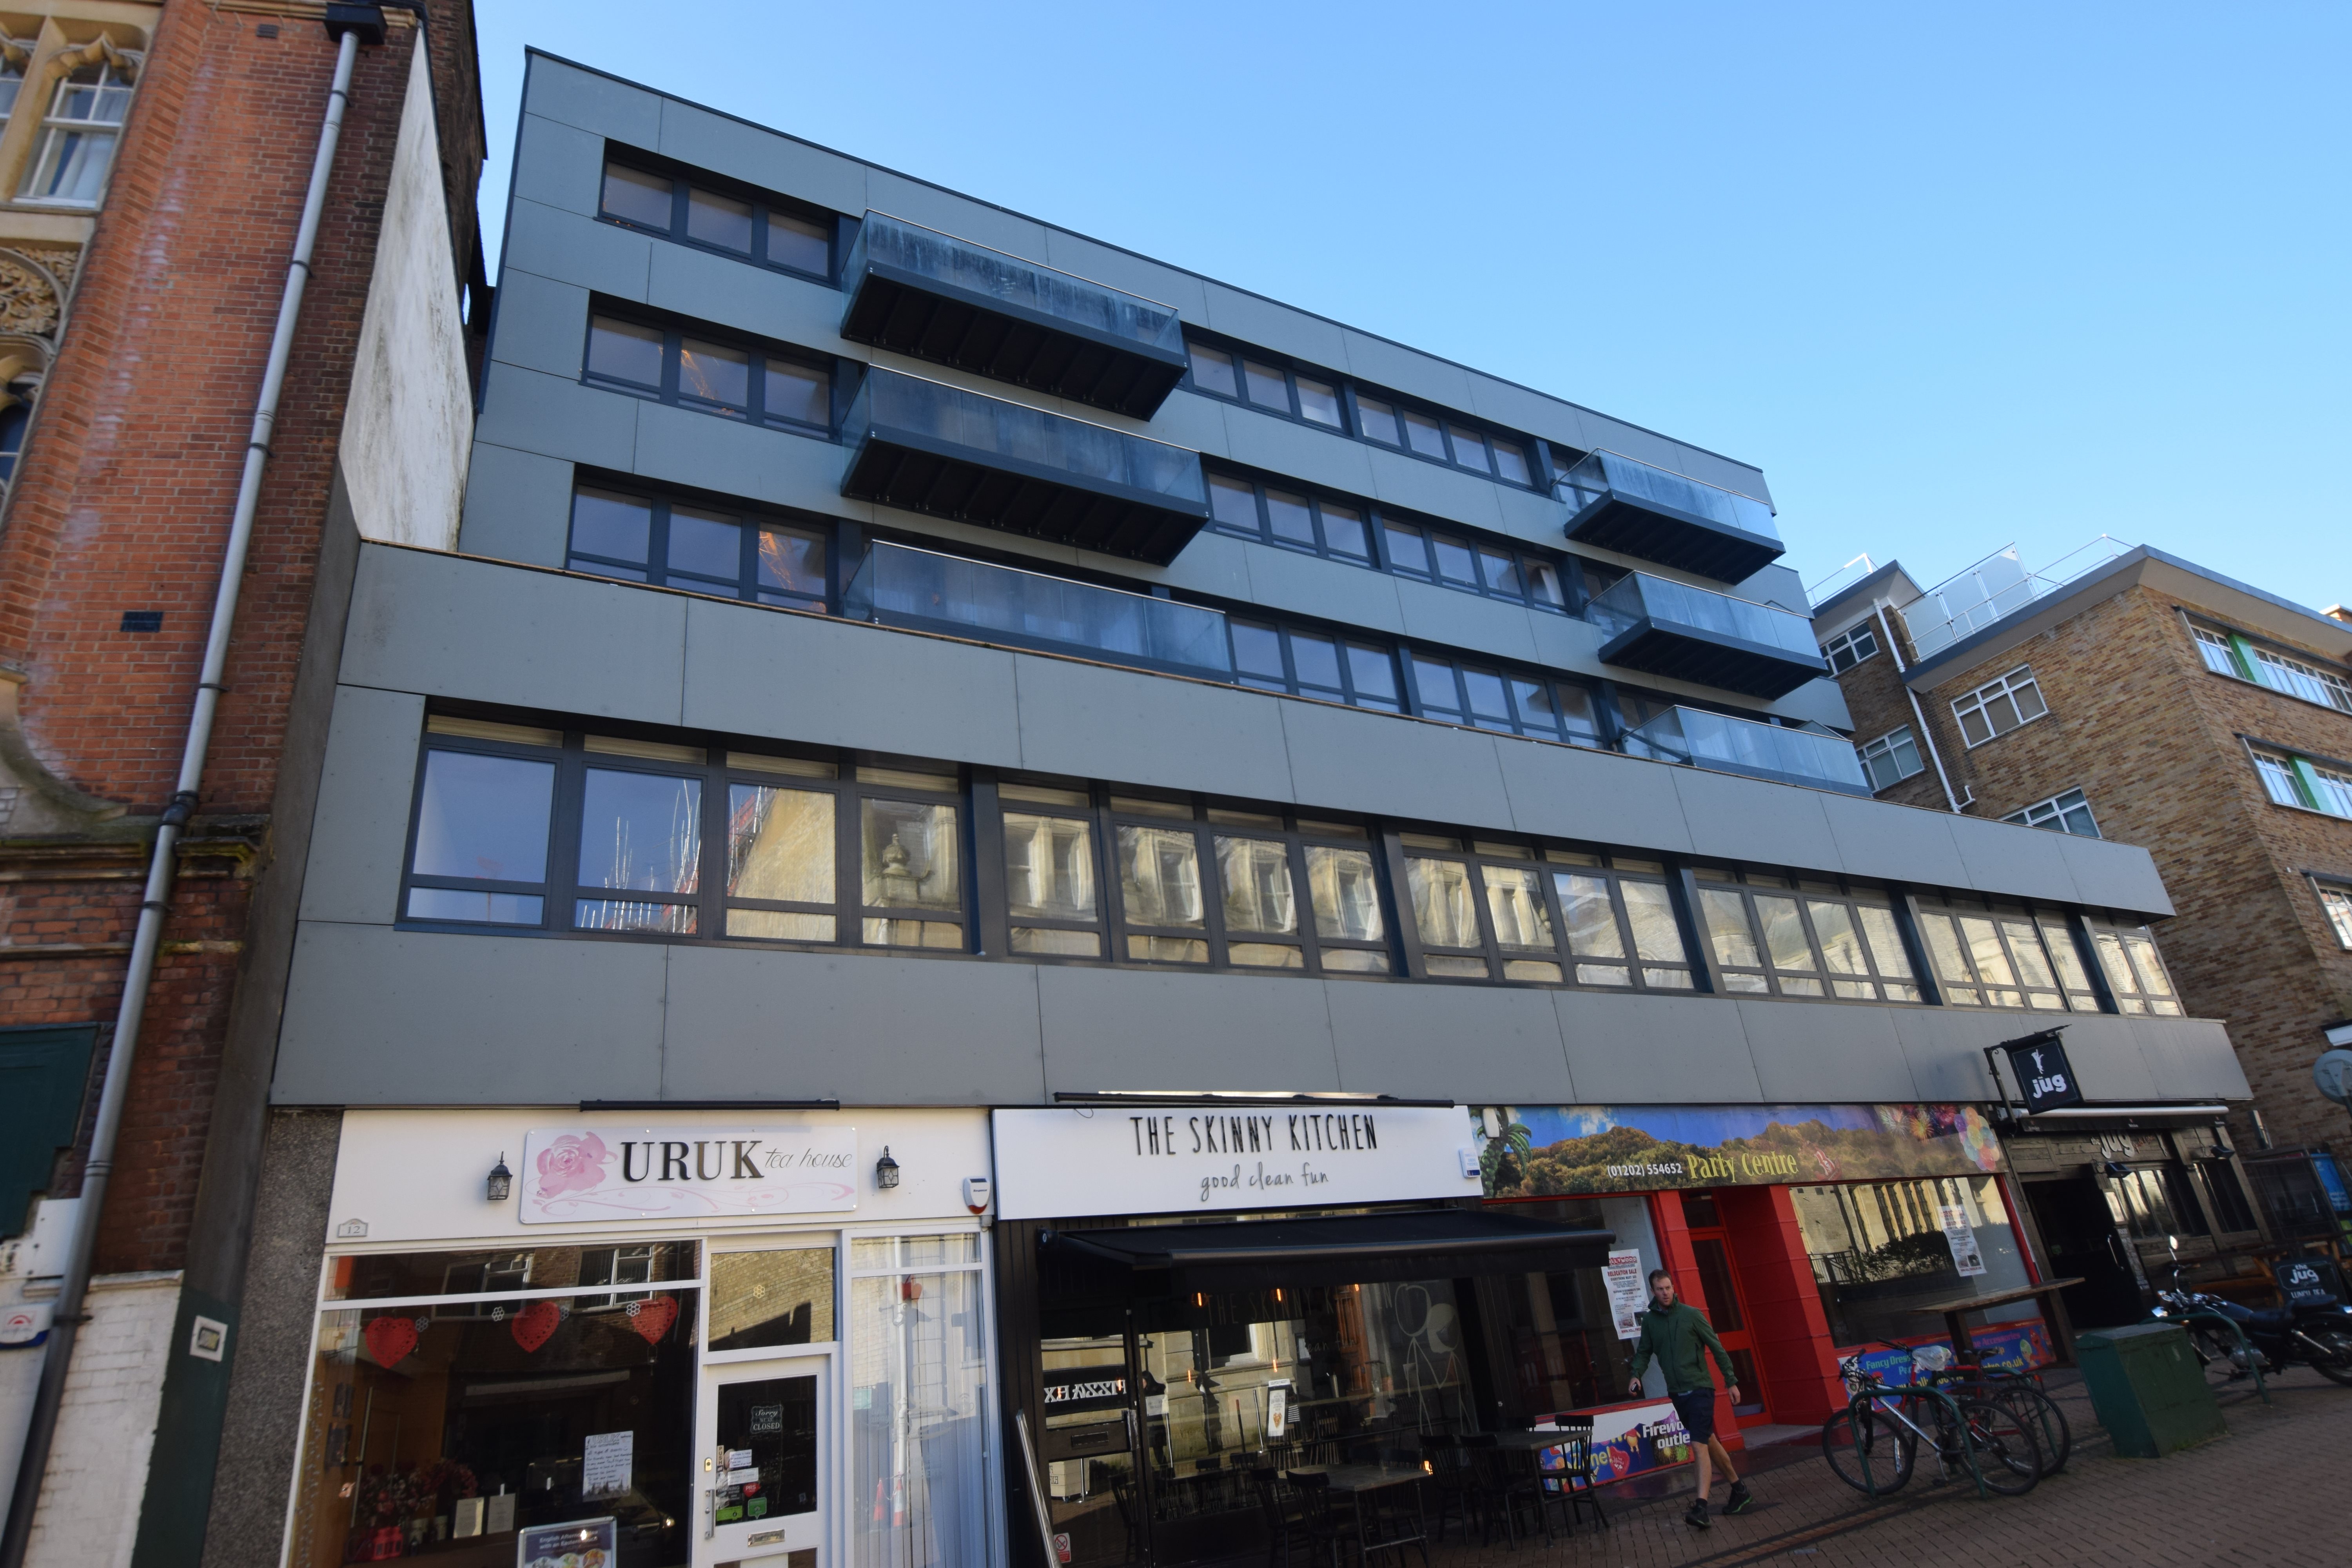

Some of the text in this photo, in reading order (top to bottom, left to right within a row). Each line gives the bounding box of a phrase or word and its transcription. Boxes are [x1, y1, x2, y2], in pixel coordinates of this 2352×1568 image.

[2032, 1074, 2067, 1098] jug
[1130, 1114, 1377, 1155] THE SKINNY KITCHEN
[620, 1141, 853, 1182] URUK tea house
[1607, 1151, 1798, 1183] (01202) 554652 Party Centre
[1201, 1161, 1329, 1202] good clean fun
[348, 1226, 360, 1234] 12
[2290, 1269, 2319, 1284] jug
[1204, 1294, 1238, 1326] THE
[1866, 1359, 1889, 1370] Fancy
[755, 1409, 778, 1417] Sorry
[753, 1423, 780, 1431] CLOSED
[561, 1530, 588, 1540] Aftern
